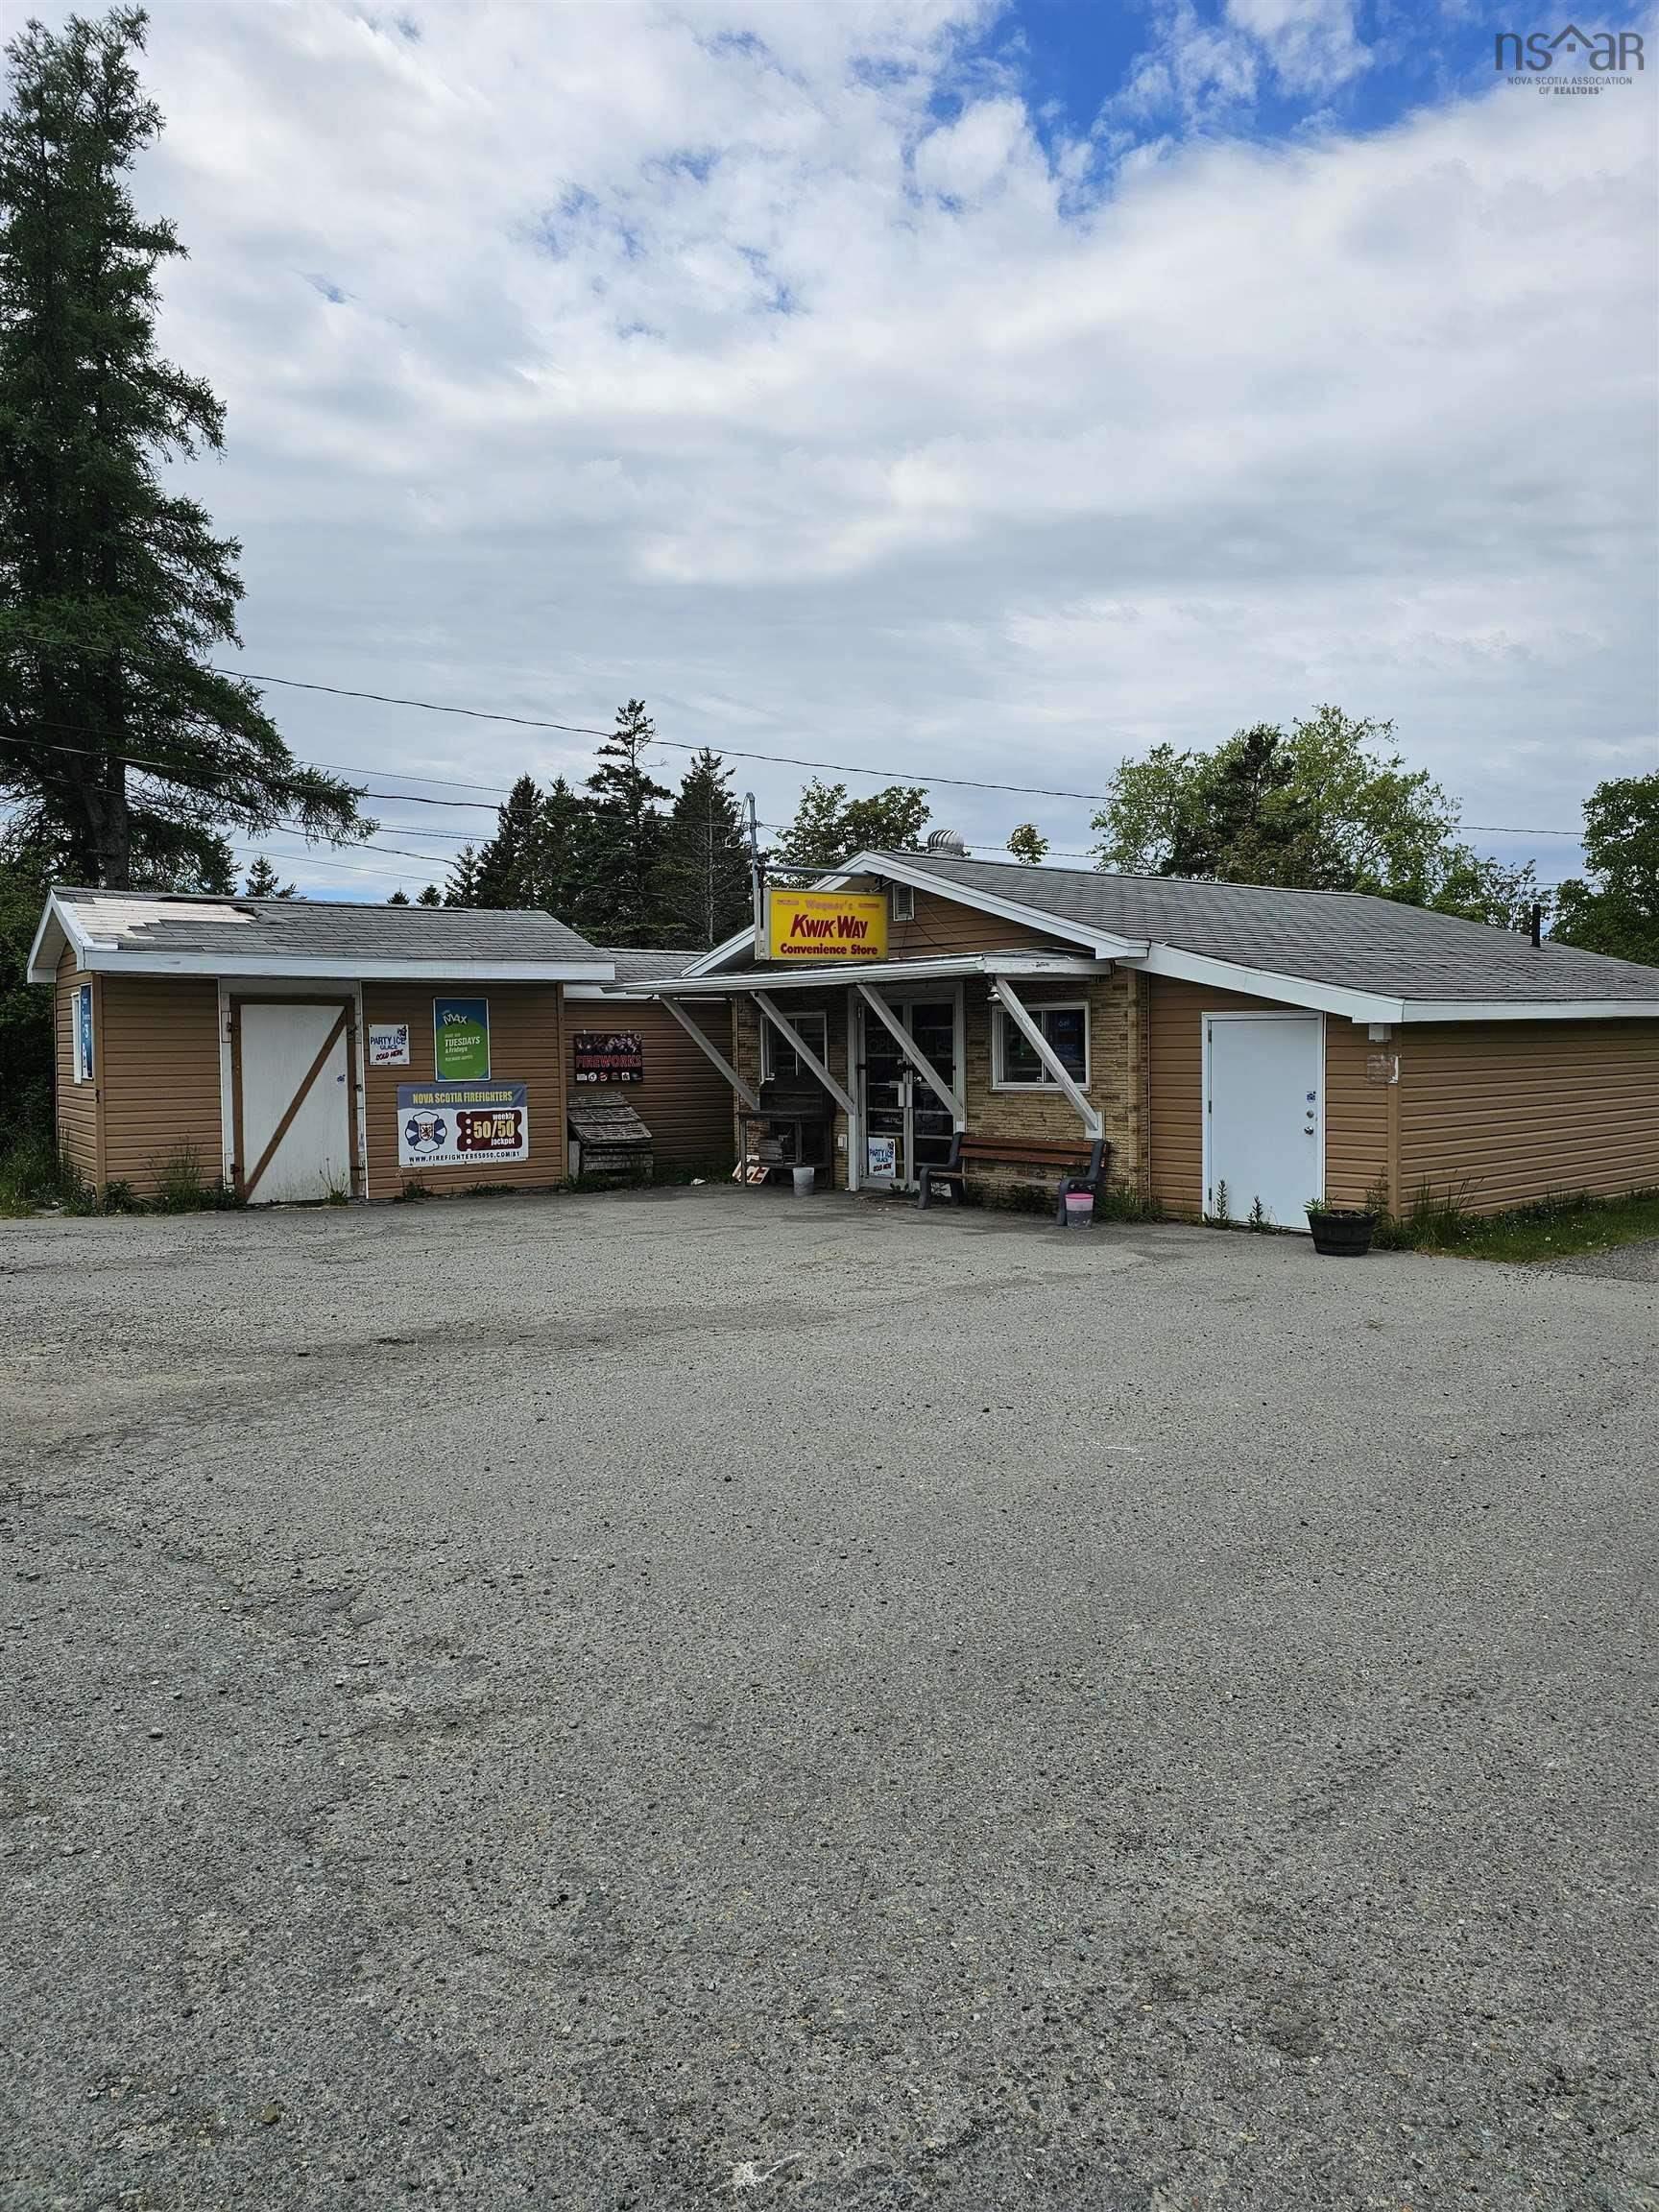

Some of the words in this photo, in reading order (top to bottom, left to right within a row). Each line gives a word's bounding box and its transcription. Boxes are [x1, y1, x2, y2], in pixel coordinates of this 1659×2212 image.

[780, 943, 847, 955] Convenience
[851, 944, 878, 955] Store
[443, 1013, 468, 1026] MAX
[370, 1036, 392, 1046] PARTY
[445, 1036, 481, 1047] TUESDAYS
[576, 1054, 642, 1069] FIREWORKS
[412, 1093, 434, 1104] NOVA
[434, 1092, 463, 1104] SCOTIA
[464, 1091, 514, 1103] FIREFIGHTERS
[492, 1112, 516, 1121] weekly
[472, 1120, 516, 1140] 50/50
[491, 1137, 516, 1146] jackpot
